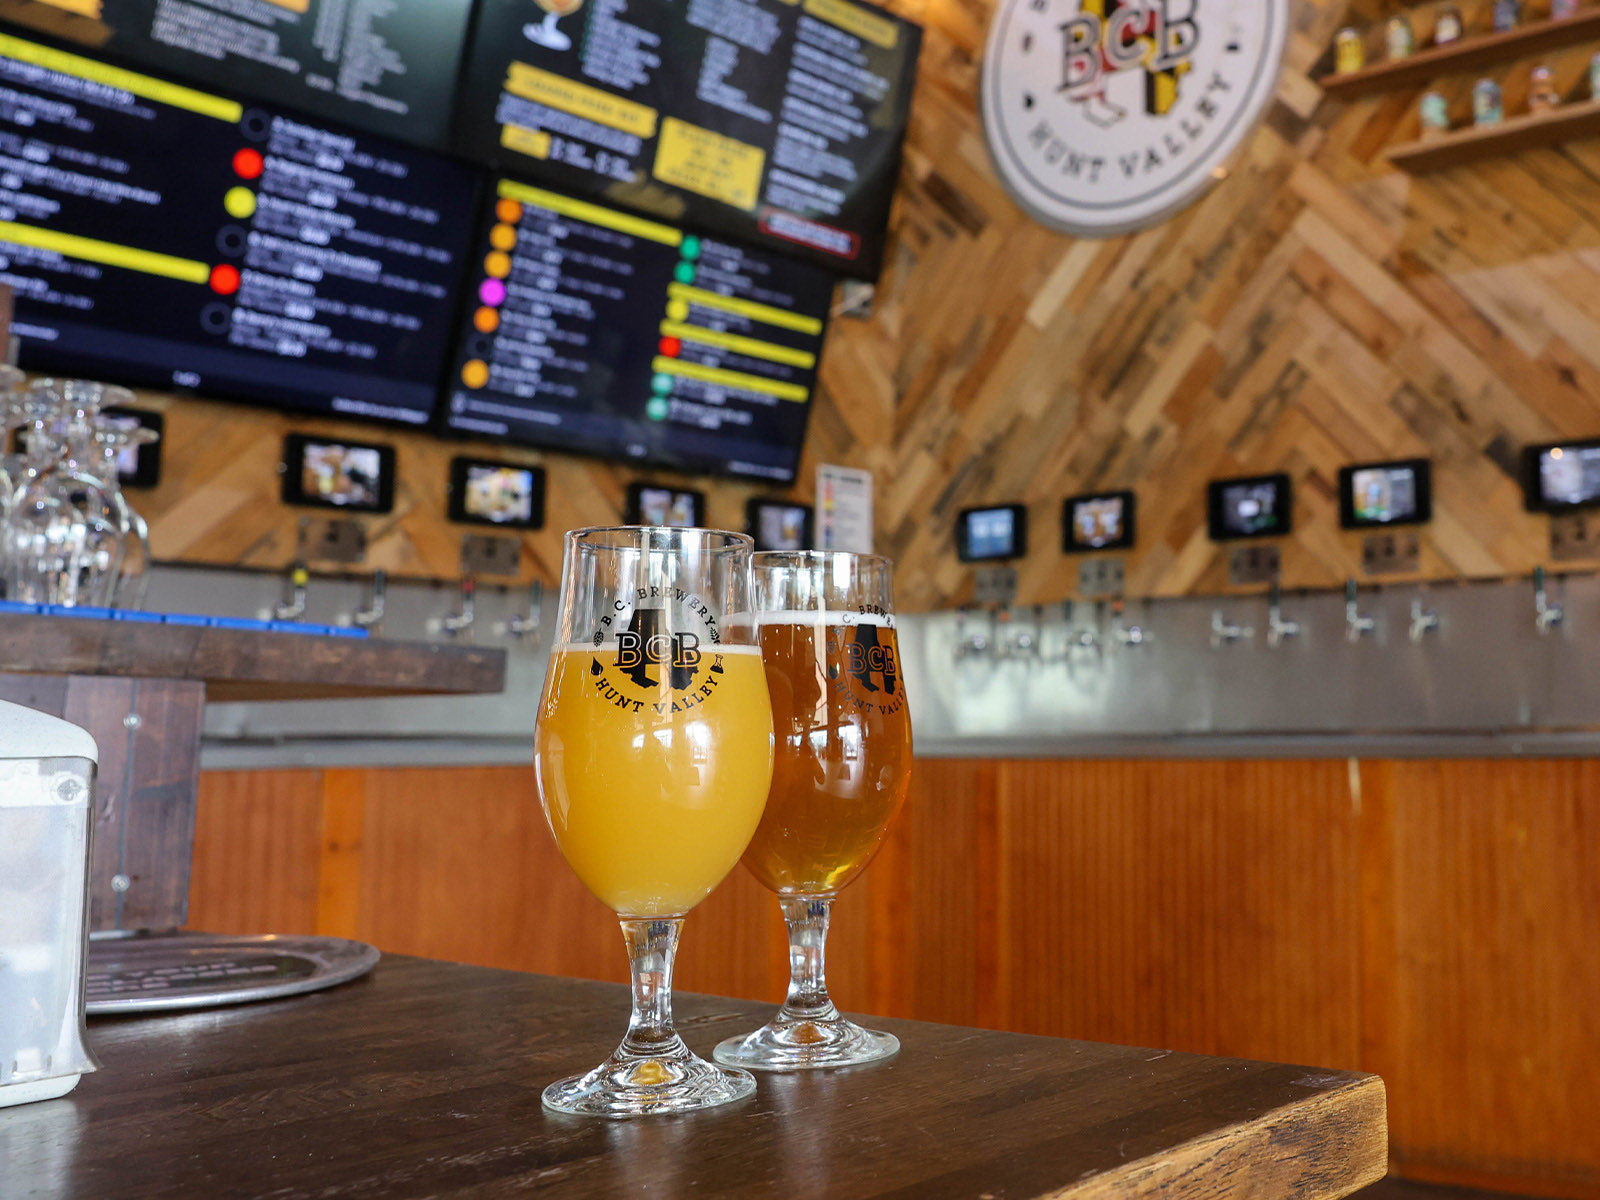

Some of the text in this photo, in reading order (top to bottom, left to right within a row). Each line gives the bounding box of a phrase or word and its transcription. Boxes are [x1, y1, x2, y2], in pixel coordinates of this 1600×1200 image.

[1056, 0, 1200, 93] BCB
[1029, 72, 1231, 183] HUNT VALLEY
[601, 586, 716, 627] B.C. BREWERY
[613, 631, 702, 669] BCB
[845, 641, 897, 676] BCB
[595, 675, 718, 714] HUNT VALLEY
[834, 681, 873, 713] HUNT
